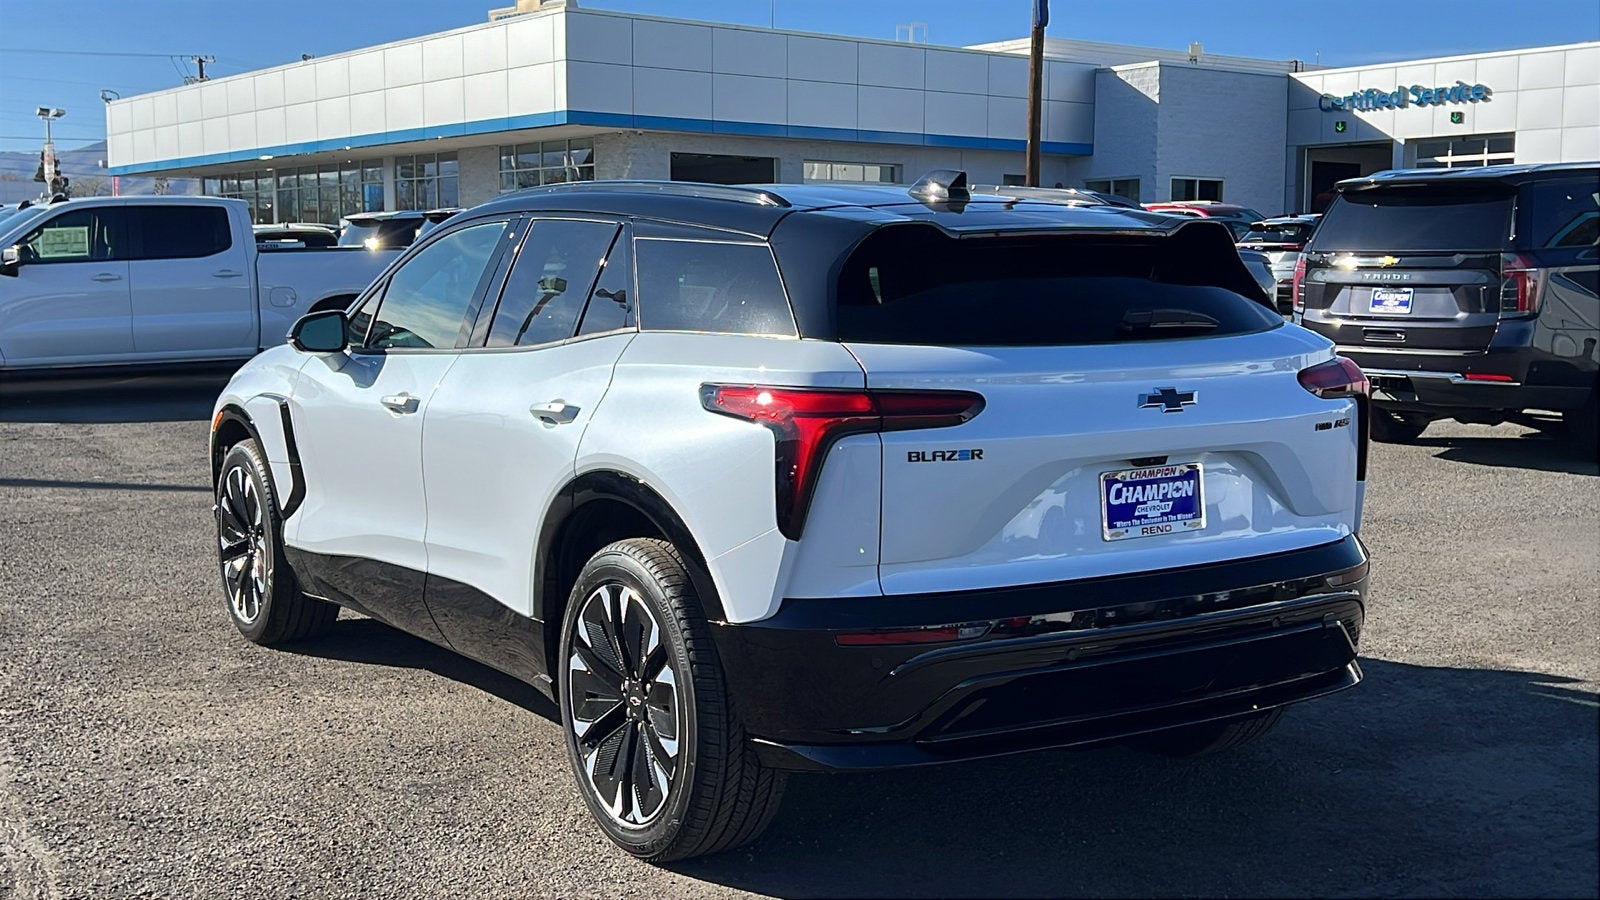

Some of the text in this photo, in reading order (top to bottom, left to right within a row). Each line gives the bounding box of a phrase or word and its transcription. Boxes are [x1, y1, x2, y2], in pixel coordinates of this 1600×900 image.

[1319, 82, 1487, 112] Certified Service
[1334, 418, 1350, 428] RS
[907, 449, 983, 462] BLAZER
[1130, 467, 1177, 480] CHAMPION
[1109, 480, 1194, 505] CHAMPION
[1136, 503, 1171, 513] CHEVROLET
[1141, 524, 1172, 536] RENO
